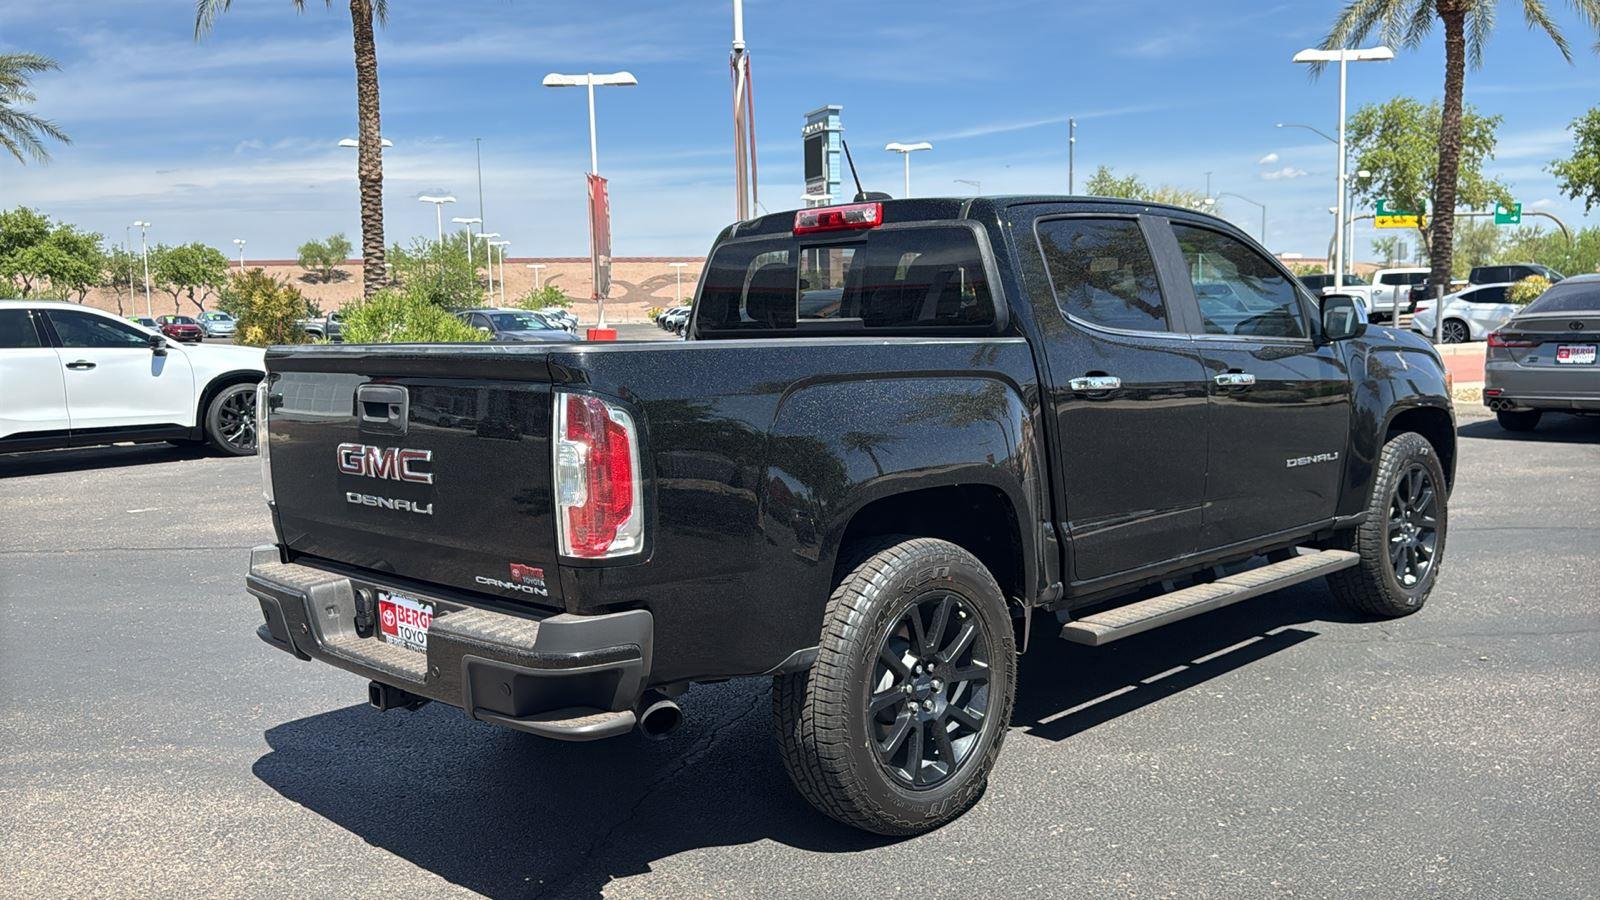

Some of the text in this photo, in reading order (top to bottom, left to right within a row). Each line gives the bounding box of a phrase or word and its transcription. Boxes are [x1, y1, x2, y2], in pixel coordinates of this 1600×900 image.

[337, 442, 433, 485] GMC
[1286, 451, 1339, 468] DENALI
[346, 491, 433, 515] DENALI
[475, 575, 549, 597] CANYON
[398, 626, 428, 644] TOYO
